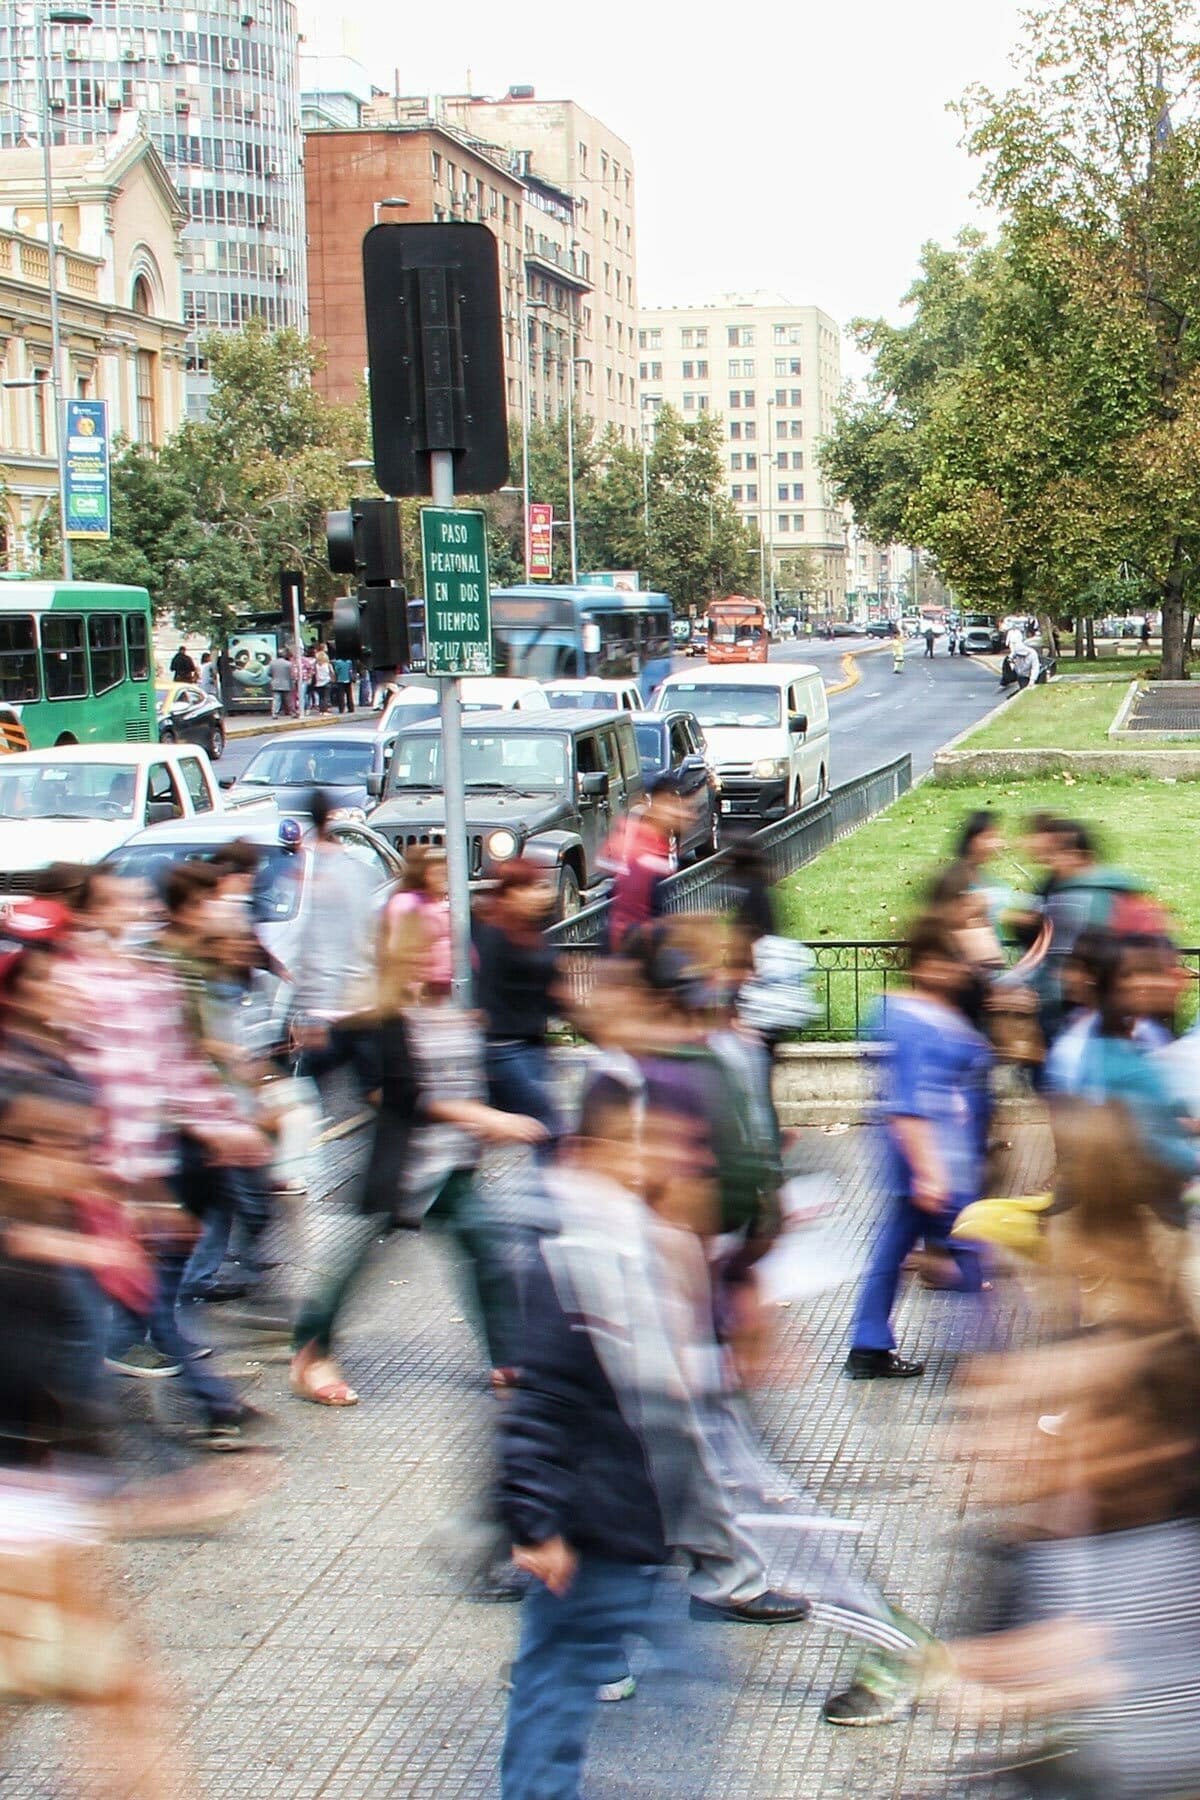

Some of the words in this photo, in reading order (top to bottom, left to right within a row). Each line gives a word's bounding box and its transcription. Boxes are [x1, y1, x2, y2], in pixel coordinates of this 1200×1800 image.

[441, 524, 467, 543] PASO
[431, 553, 481, 573] PEATONAL
[435, 582, 448, 602] EN
[460, 584, 479, 602] DOS
[437, 612, 479, 631] TIEMPOS
[429, 641, 440, 660] DE
[444, 641, 460, 661] LUZ
[462, 641, 489, 661] VERDE
